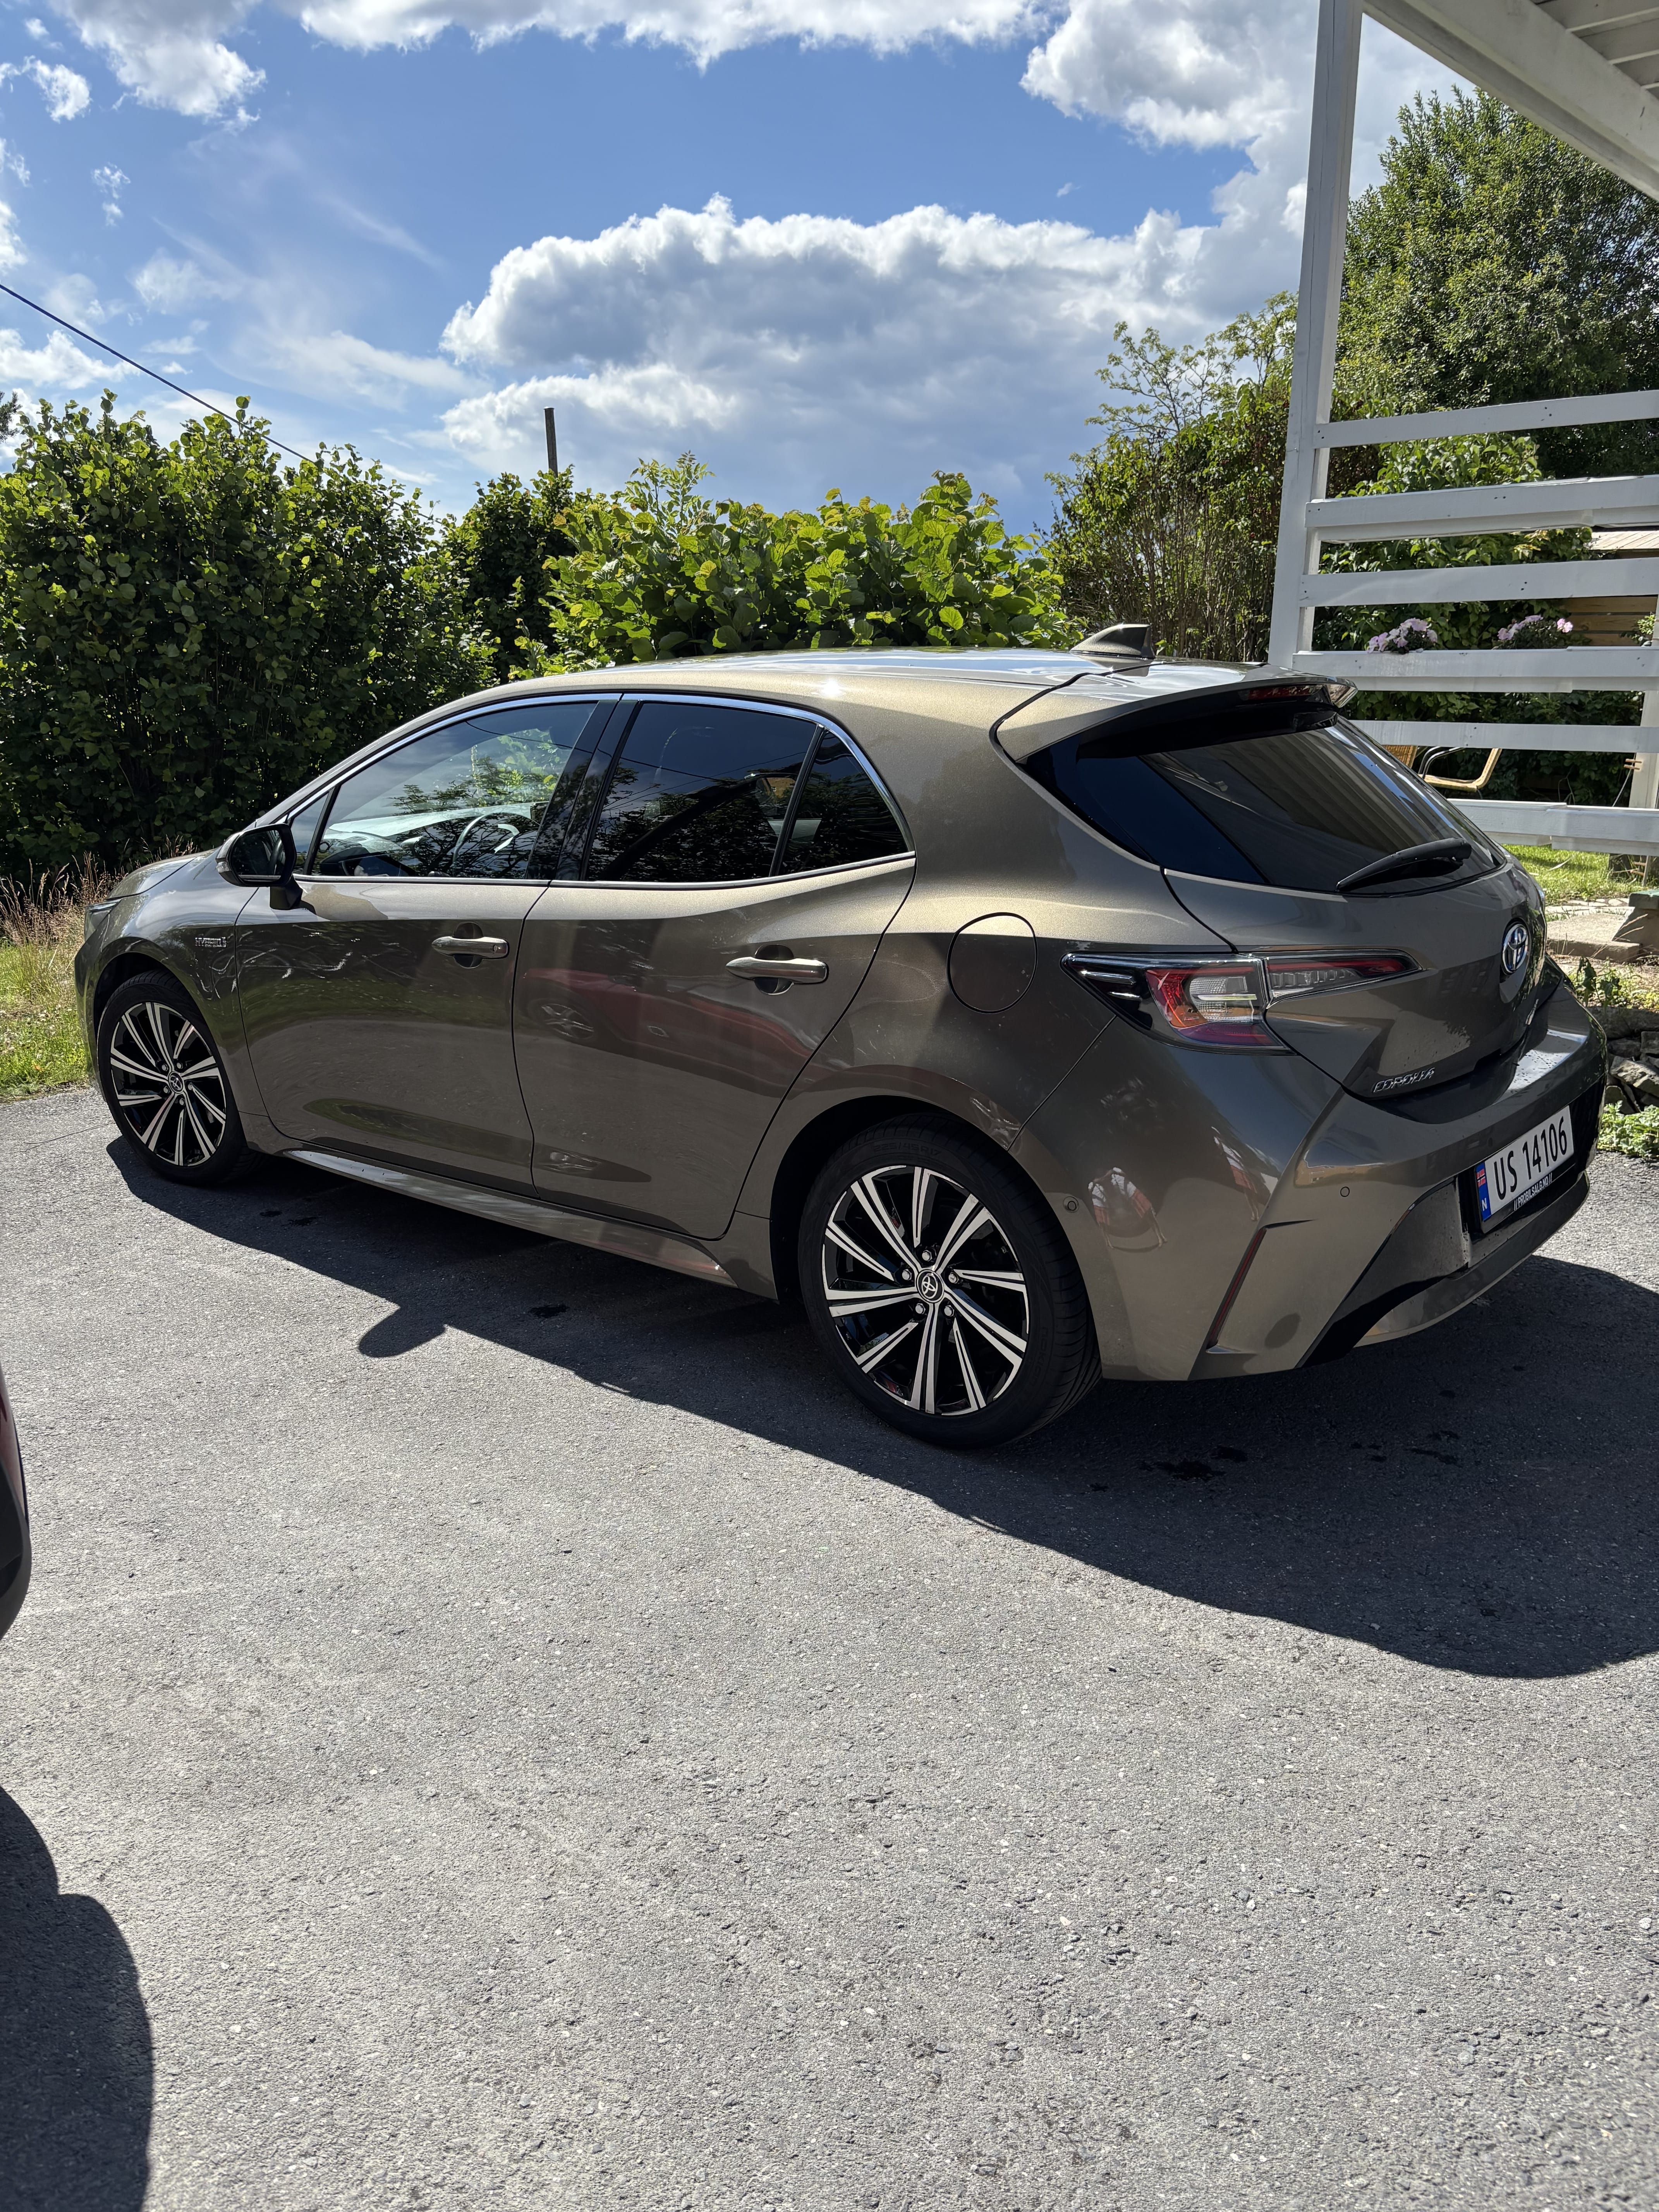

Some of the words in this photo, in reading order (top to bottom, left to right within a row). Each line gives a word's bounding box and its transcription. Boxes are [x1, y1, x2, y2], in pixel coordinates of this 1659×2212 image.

[1372, 1068, 1435, 1093] COROLLA
[1494, 1151, 1517, 1200] US
[1522, 1116, 1567, 1180] 14106
[1481, 1197, 1487, 1211] N
